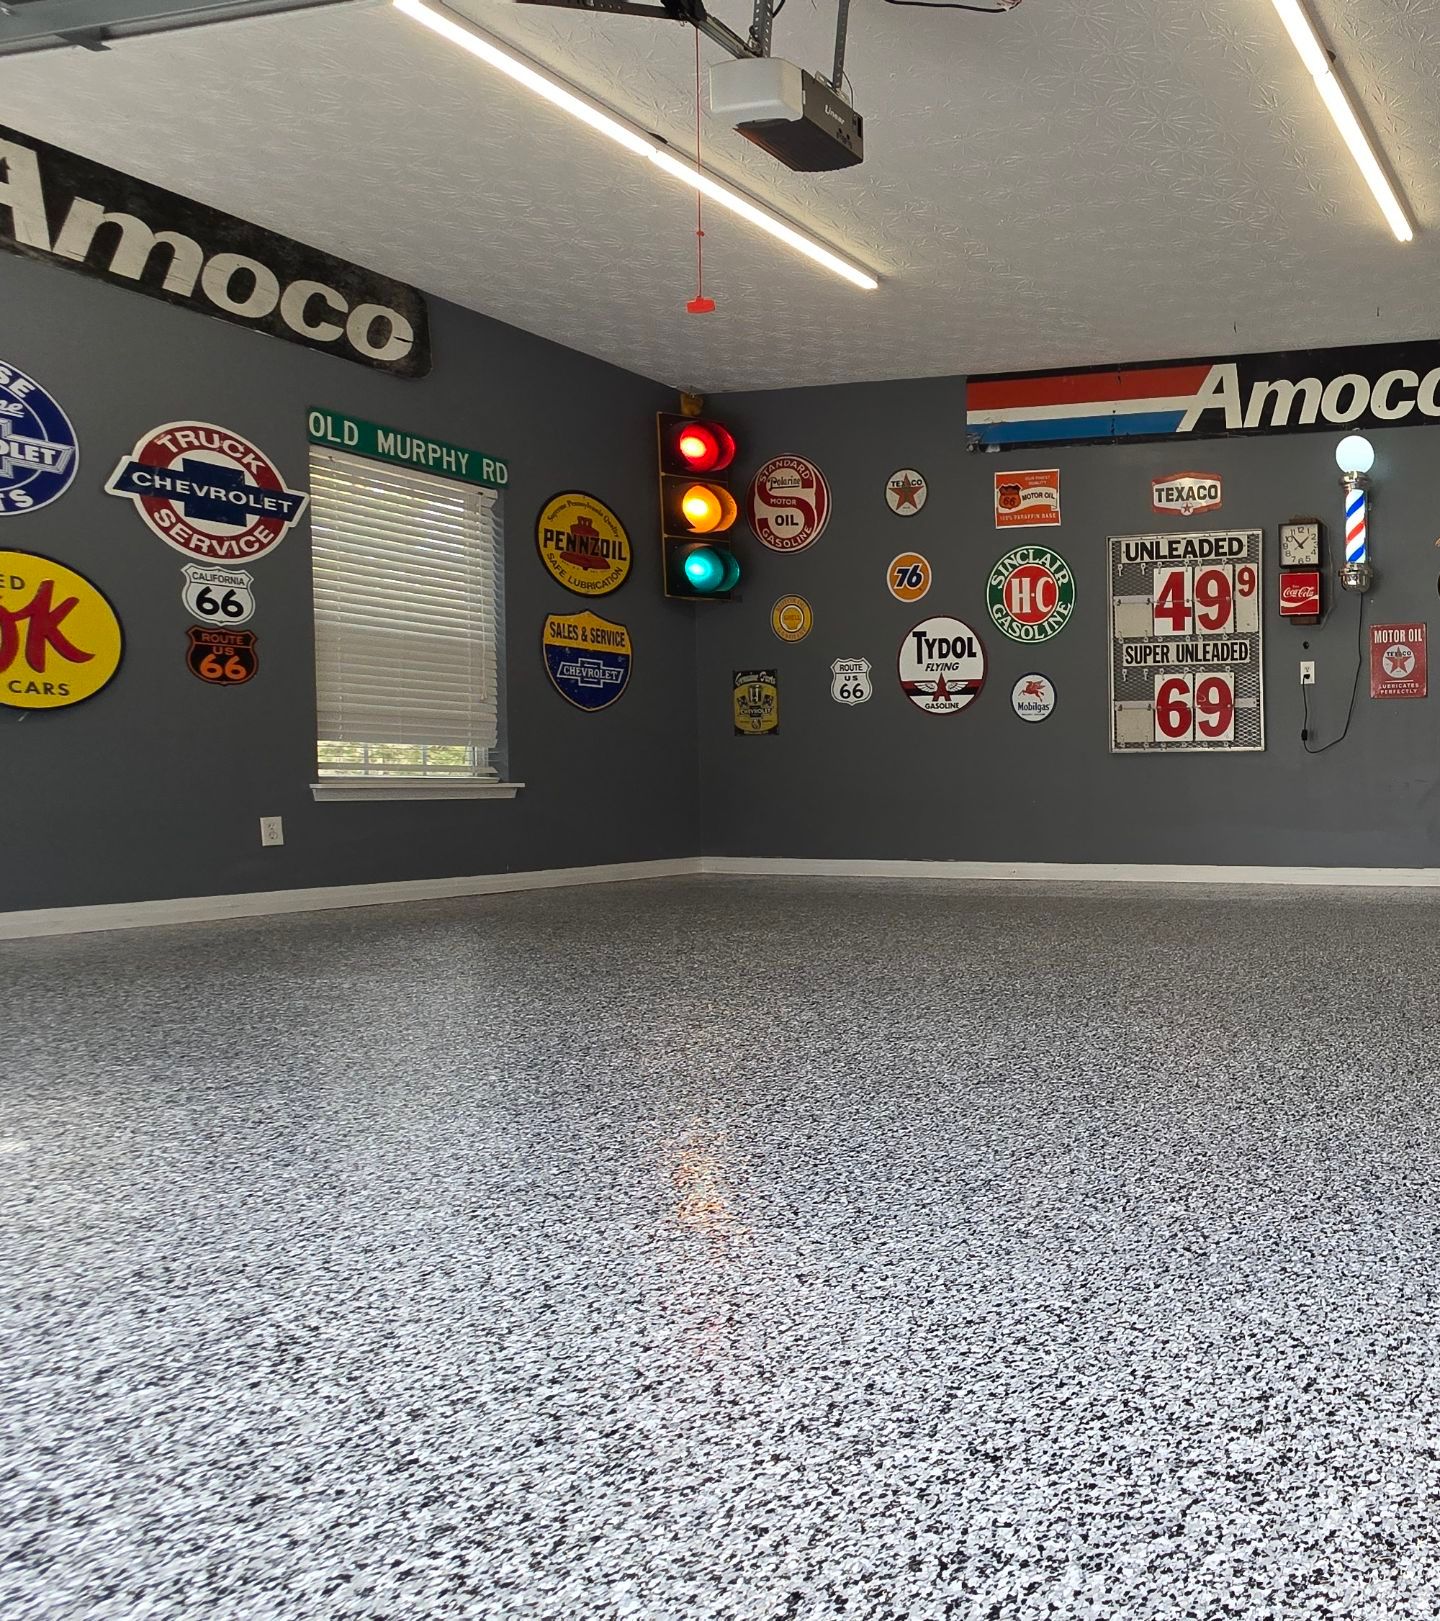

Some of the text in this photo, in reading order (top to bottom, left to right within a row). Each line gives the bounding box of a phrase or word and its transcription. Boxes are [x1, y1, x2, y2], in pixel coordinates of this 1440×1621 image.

[0, 137, 414, 361] Amoco
[155, 430, 266, 475] TRUCK
[309, 411, 508, 484] OLD MURPHY RD
[131, 472, 293, 513] CHEVROLET
[1003, 497, 1016, 506] 66
[1022, 492, 1055, 501] MOTOR OIL
[1155, 484, 1218, 503] TEXACO
[154, 508, 275, 556] SERVICE
[775, 514, 799, 526] OIL
[543, 528, 627, 561] PENNZOIL
[762, 525, 812, 548] GASOLINE
[1125, 537, 1244, 561] UNLEADED
[191, 571, 246, 586] CALIFORNIA
[547, 553, 567, 578] SAFE
[568, 567, 623, 590] LUBRICATION
[895, 563, 923, 589] 76
[991, 549, 1069, 589] SINCLAIR
[1237, 566, 1255, 597] 9
[195, 586, 244, 618] 66
[992, 601, 1072, 640] GASOLINE
[202, 633, 244, 645] ROUTE
[550, 621, 626, 647] SALES & SERVICE
[1374, 628, 1422, 644] MOTOR OIL
[213, 646, 235, 656] US
[912, 631, 977, 665] TYDOL
[1125, 641, 1249, 665] SUPER UNLEADED
[200, 653, 247, 680] 66
[563, 665, 618, 680] CHEVROLET
[839, 663, 863, 672] ROUTE
[925, 662, 960, 672] FLYING
[8, 680, 70, 697] CARS
[839, 683, 864, 699] 66
[924, 702, 960, 710] GASOLINE
[1017, 701, 1050, 713] Mobilgas
[1156, 676, 1233, 738] 69
